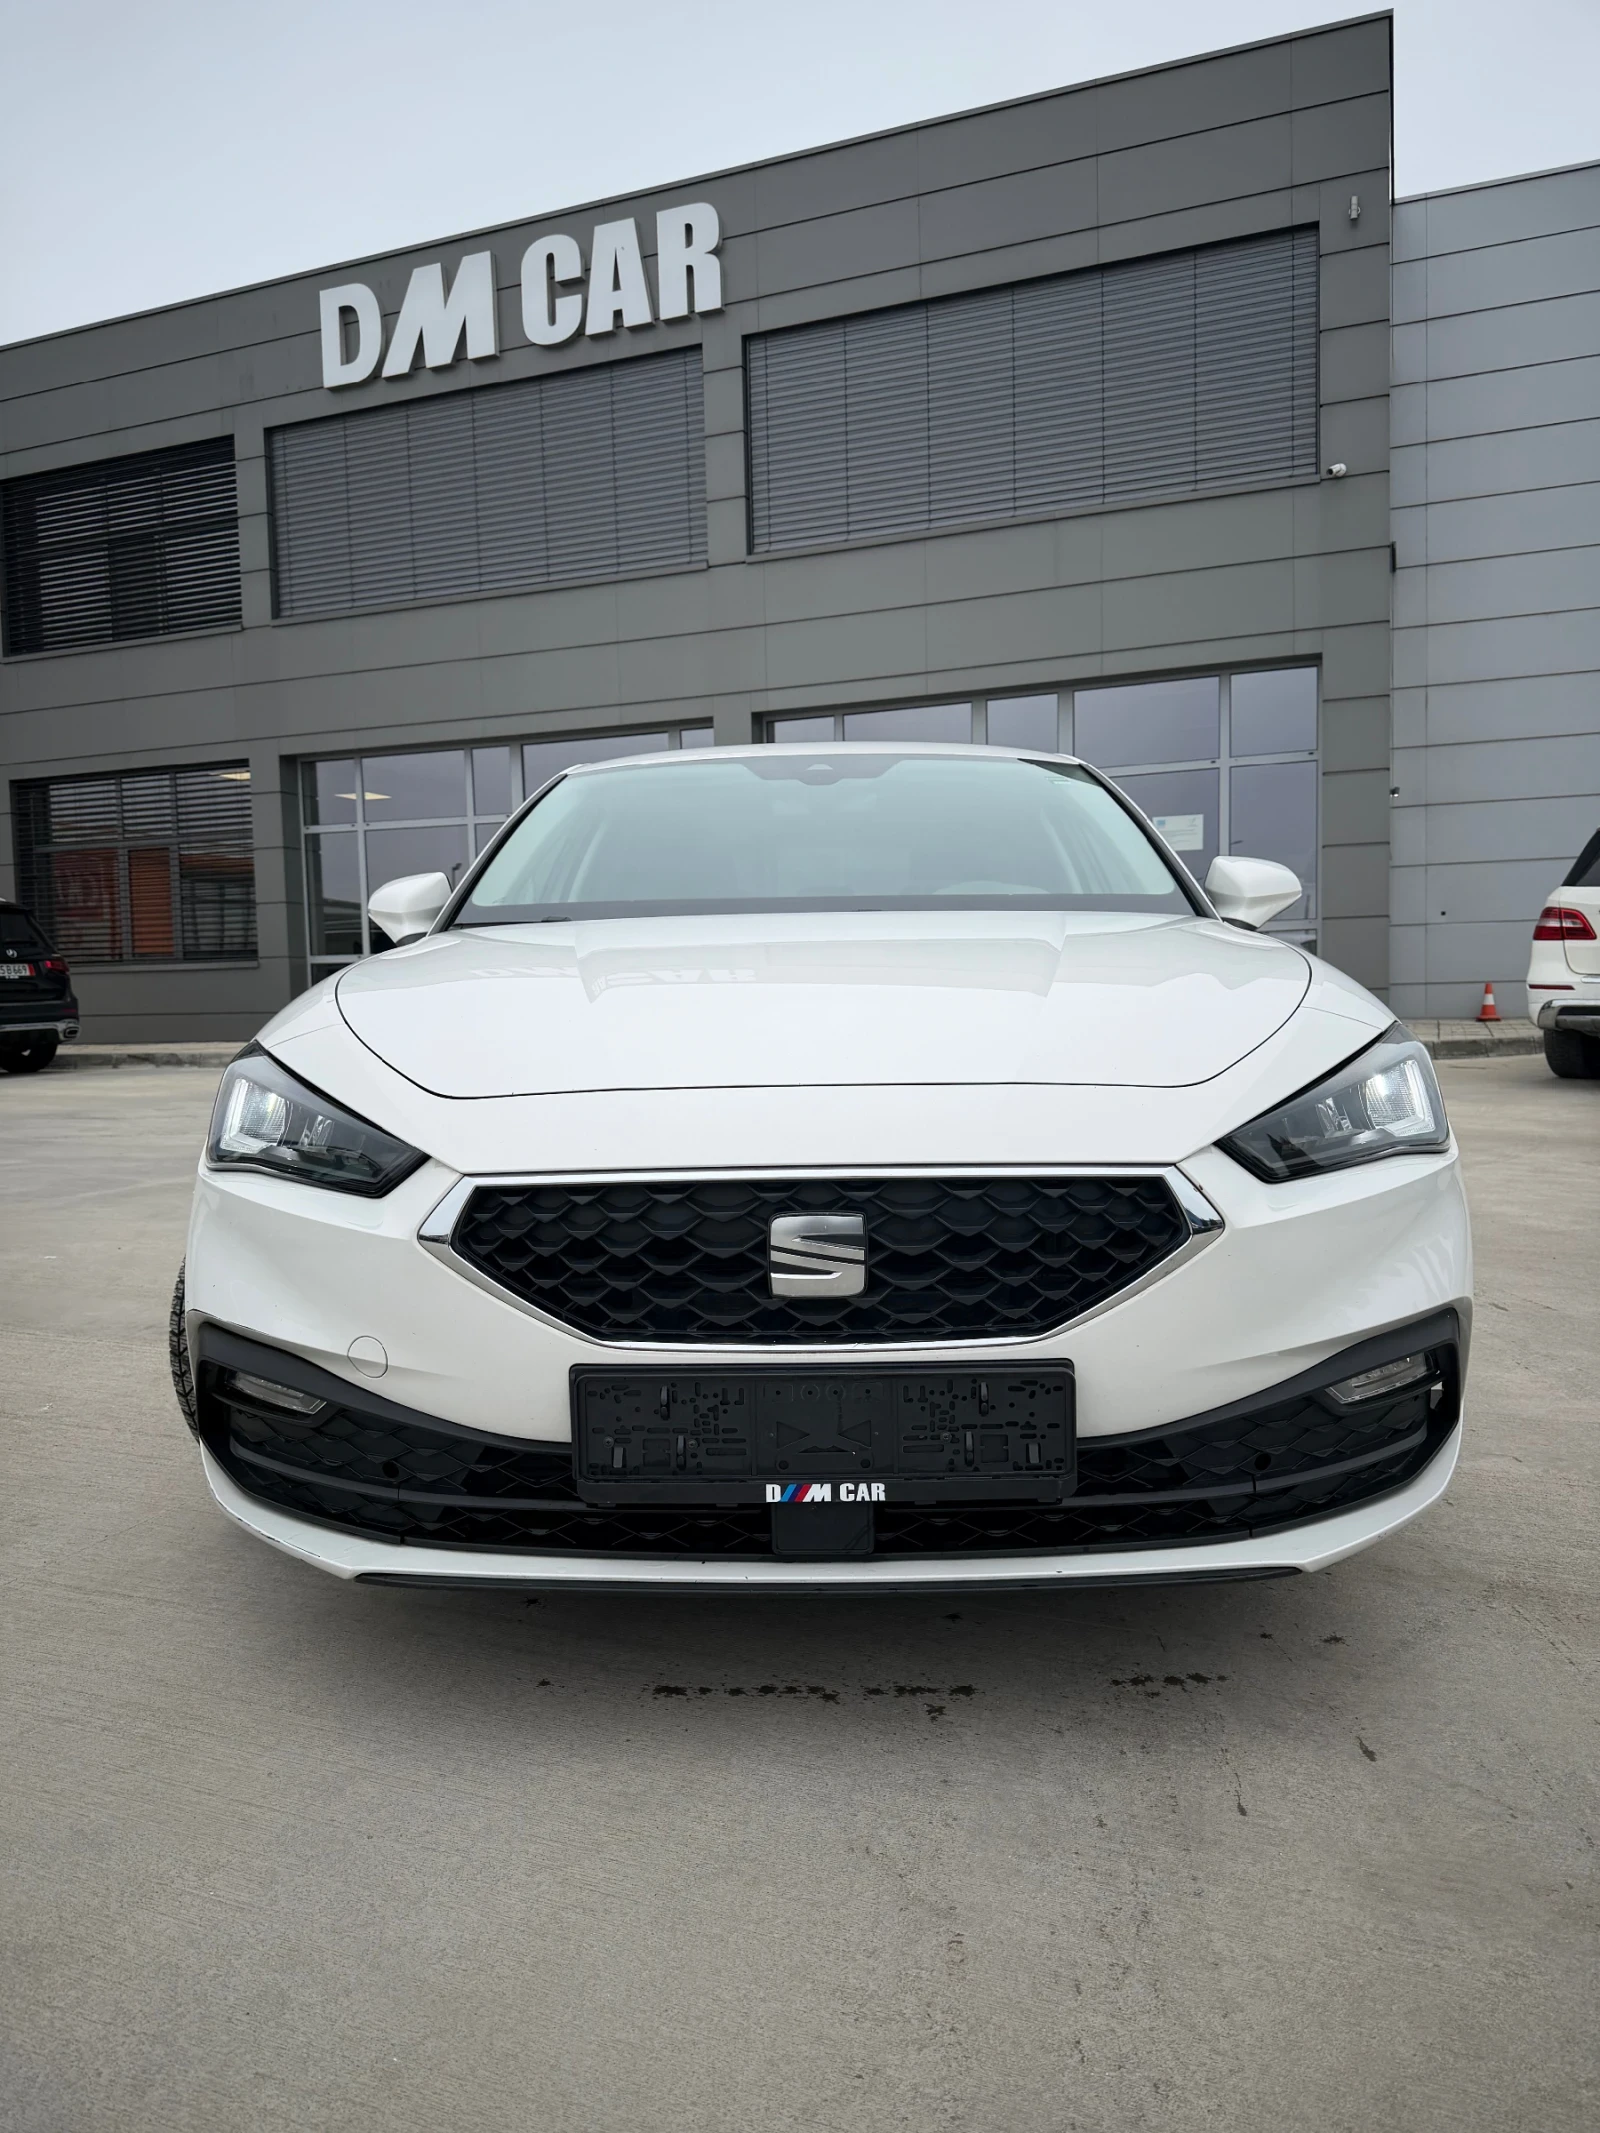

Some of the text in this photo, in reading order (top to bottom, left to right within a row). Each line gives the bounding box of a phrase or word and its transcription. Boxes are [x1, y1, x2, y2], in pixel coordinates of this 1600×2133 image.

[319, 202, 725, 389] DM CAR
[839, 1482, 886, 1502] CAR
